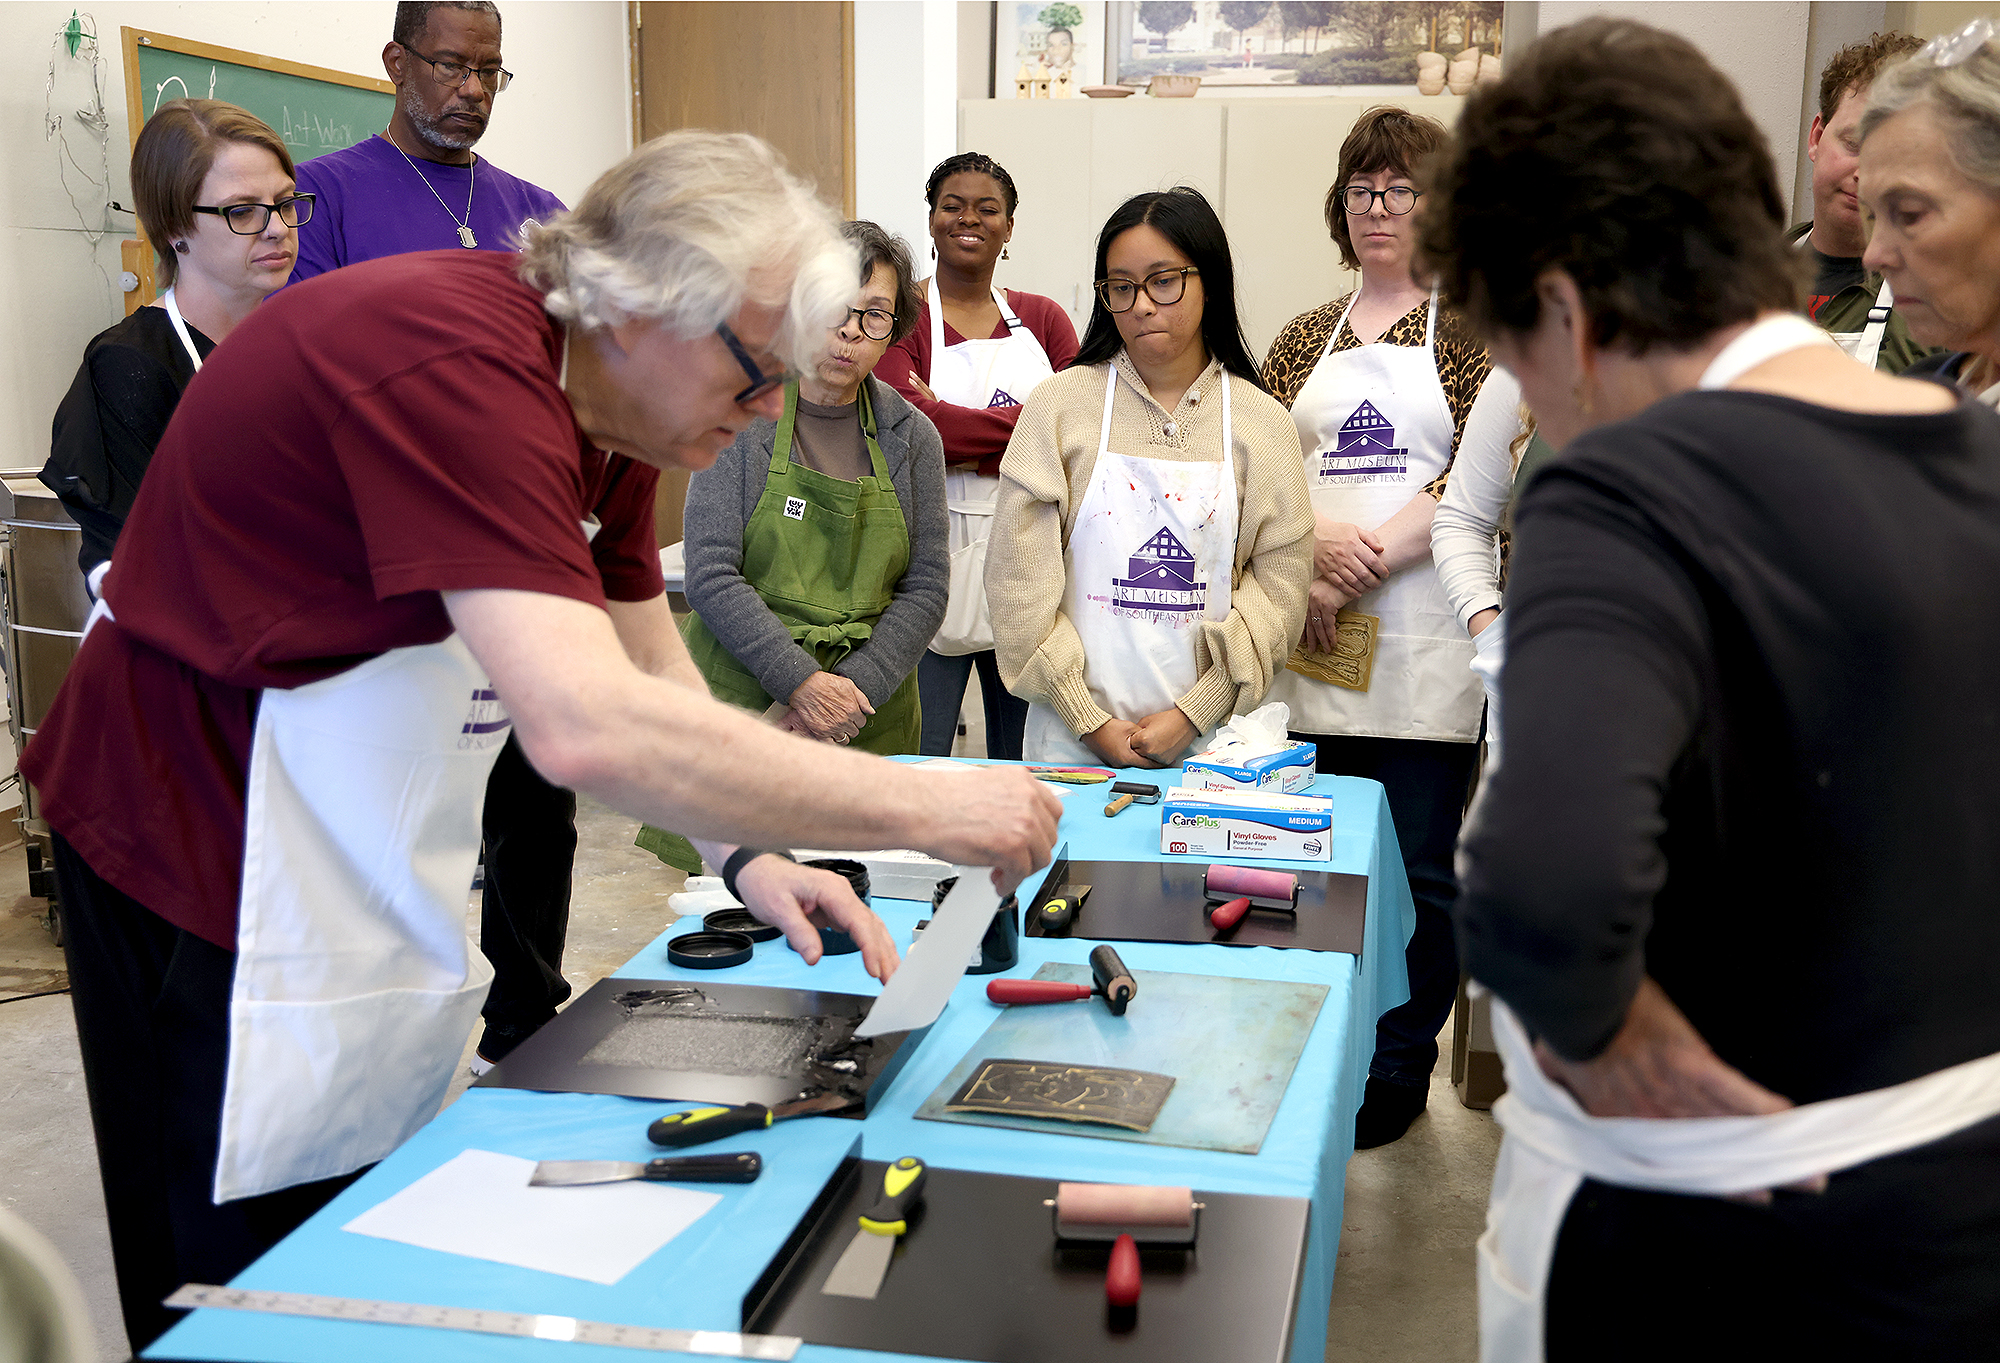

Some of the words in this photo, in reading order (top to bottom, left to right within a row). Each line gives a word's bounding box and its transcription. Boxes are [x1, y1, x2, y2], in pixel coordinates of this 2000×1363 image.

[1321, 458, 1342, 469] ART
[1346, 455, 1406, 468] MUSEUM
[1318, 476, 1329, 485] OF
[1330, 475, 1377, 484] SOUTHEAST
[1380, 474, 1406, 483] TEXAS
[1113, 587, 1137, 600] ART
[1113, 607, 1124, 616] OF
[1126, 609, 1181, 621] SOUTHEAST
[465, 701, 493, 722] ART
[1188, 766, 1212, 776] CarePlus
[1172, 815, 1218, 827] CarePlus
[1289, 817, 1322, 825] MEDIUM
[1252, 833, 1277, 841] Gloves
[1171, 843, 1186, 852] 100
